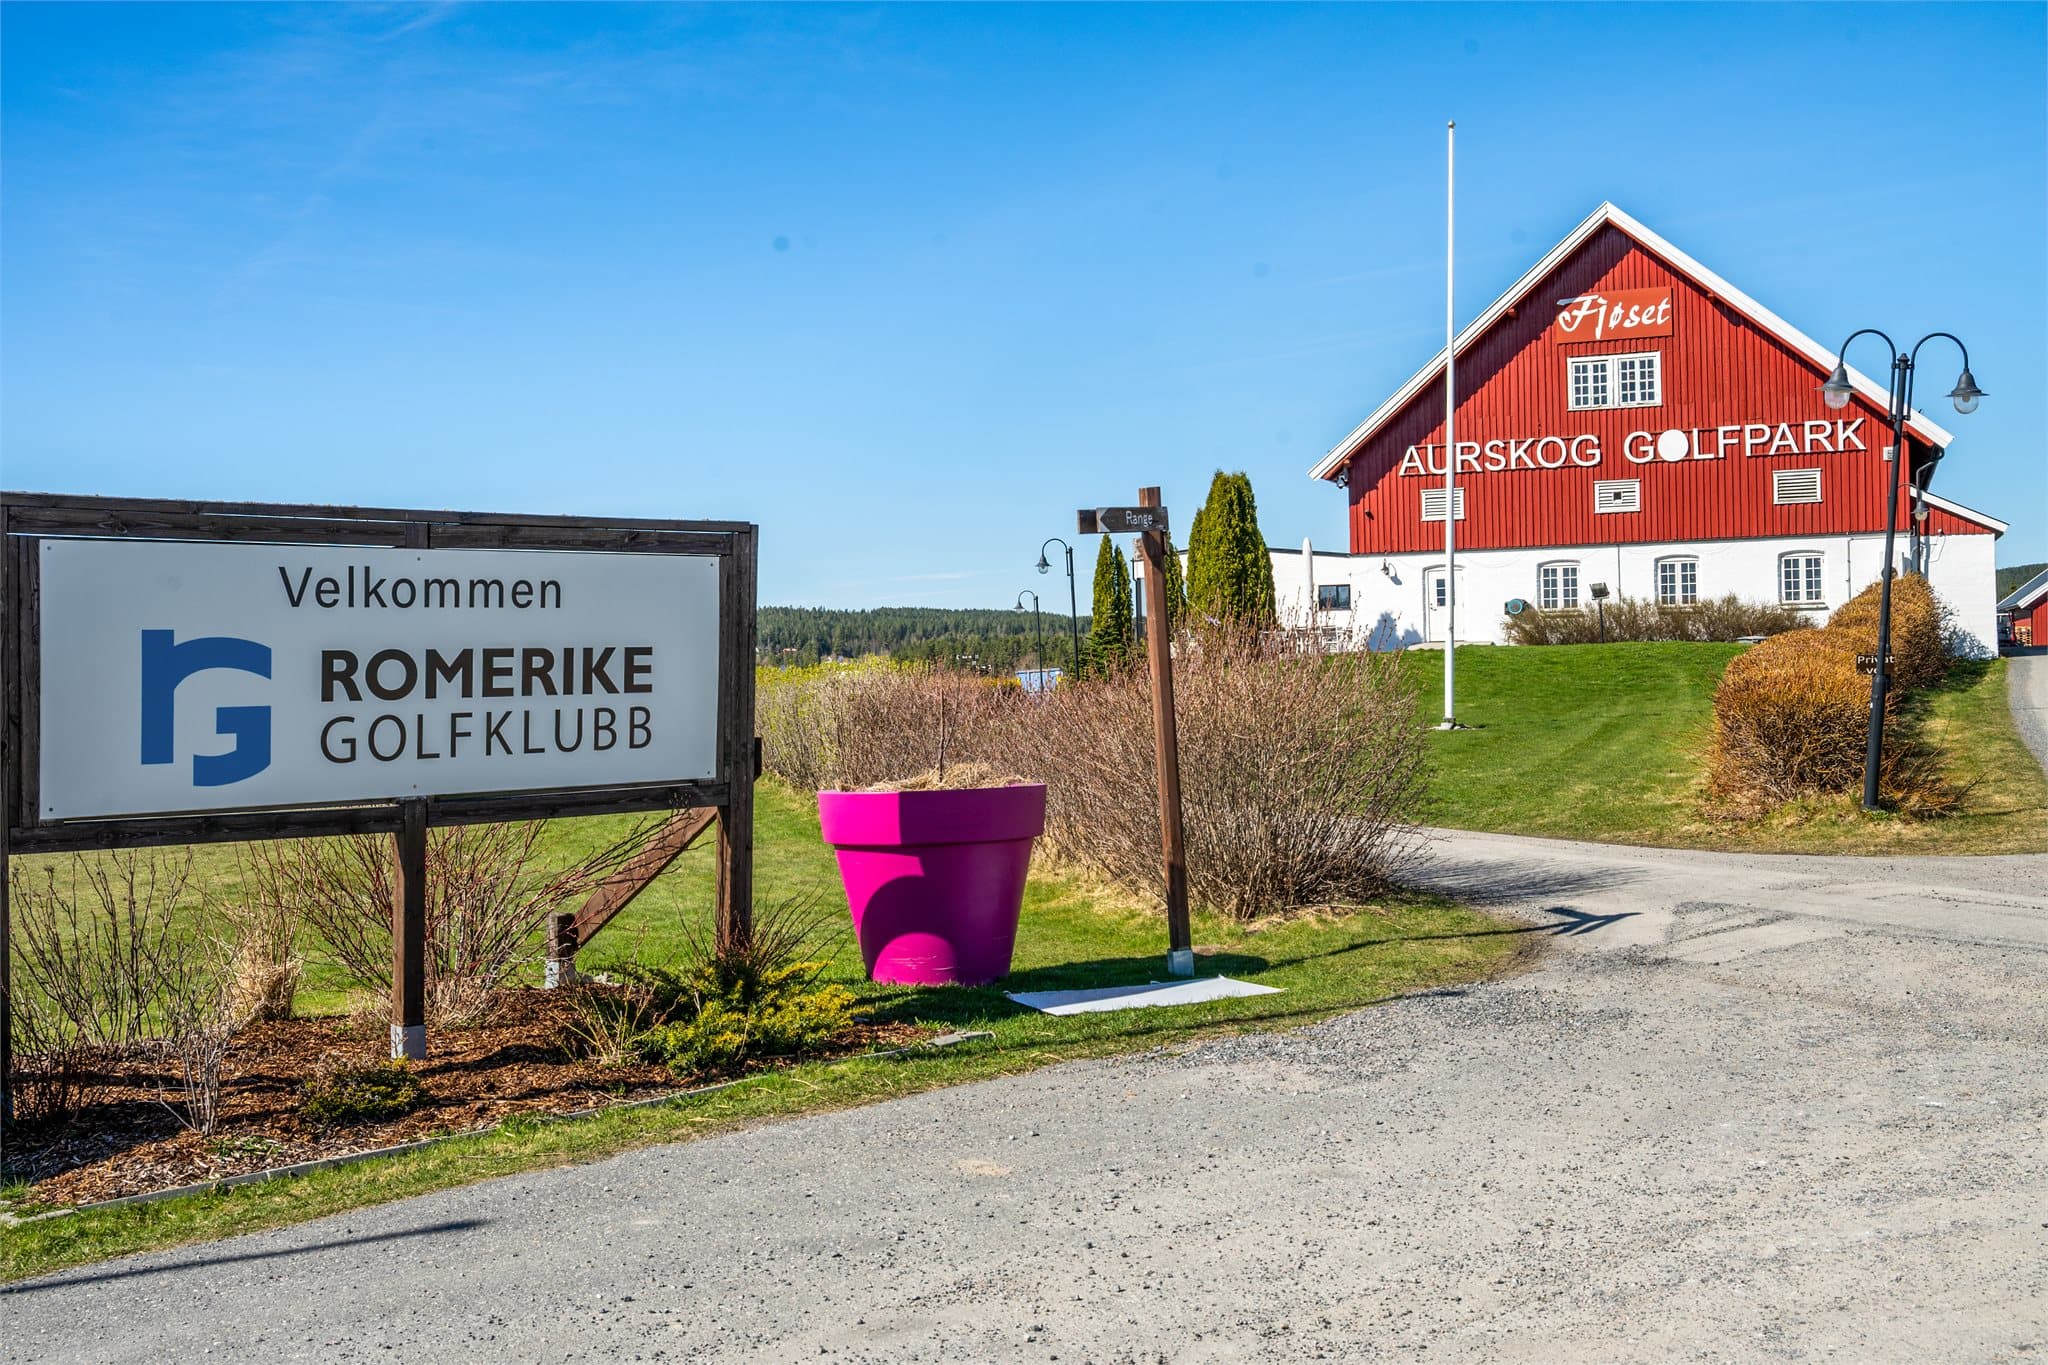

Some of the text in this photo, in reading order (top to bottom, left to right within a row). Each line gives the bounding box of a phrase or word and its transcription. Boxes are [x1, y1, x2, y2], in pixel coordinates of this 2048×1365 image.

[1556, 294, 1671, 340] Fjøset
[1399, 417, 1867, 476] AURSKOG GOLFPARK
[1125, 510, 1153, 528] Range
[278, 565, 563, 609] Velkommen
[320, 645, 654, 703] ROMERIKE
[319, 705, 653, 764] GOLFKLUBB
